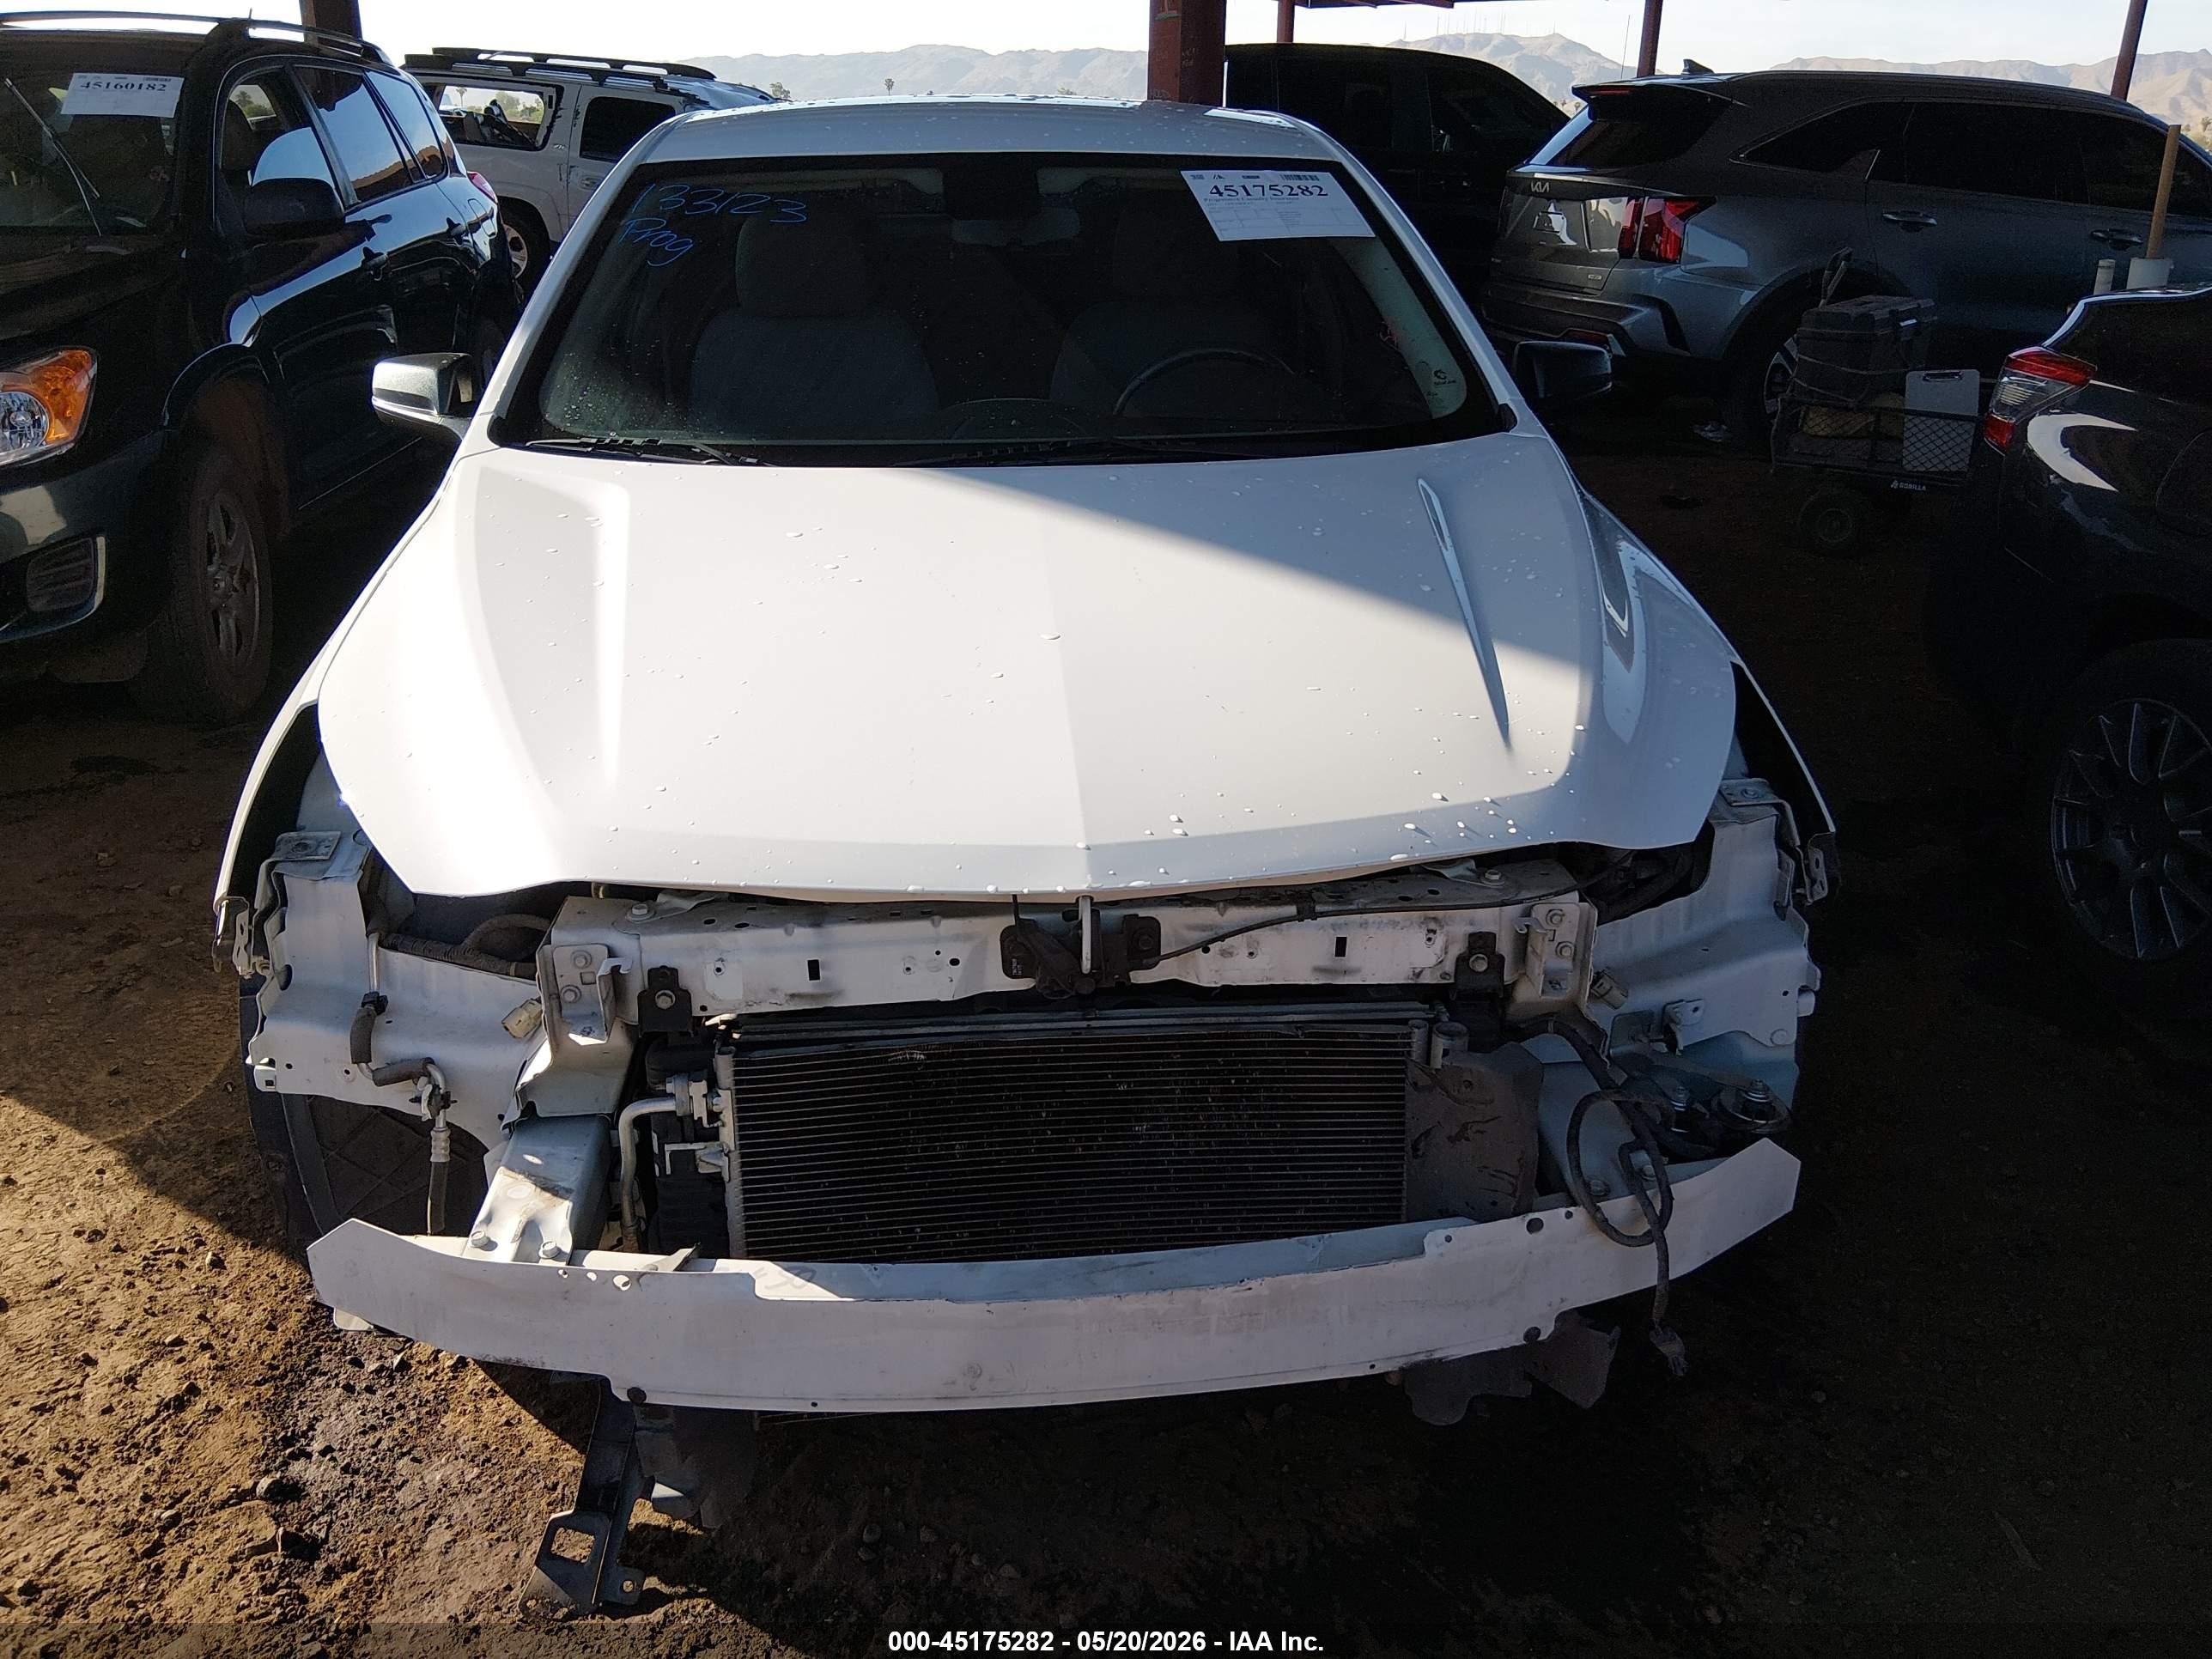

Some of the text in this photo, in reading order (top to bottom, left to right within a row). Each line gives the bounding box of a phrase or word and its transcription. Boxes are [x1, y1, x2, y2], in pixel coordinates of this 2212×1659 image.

[80, 82, 167, 91] 45160182
[1209, 185, 1328, 197] 45175282
[1530, 181, 1550, 193] KIA
[617, 217, 696, 267] Prog
